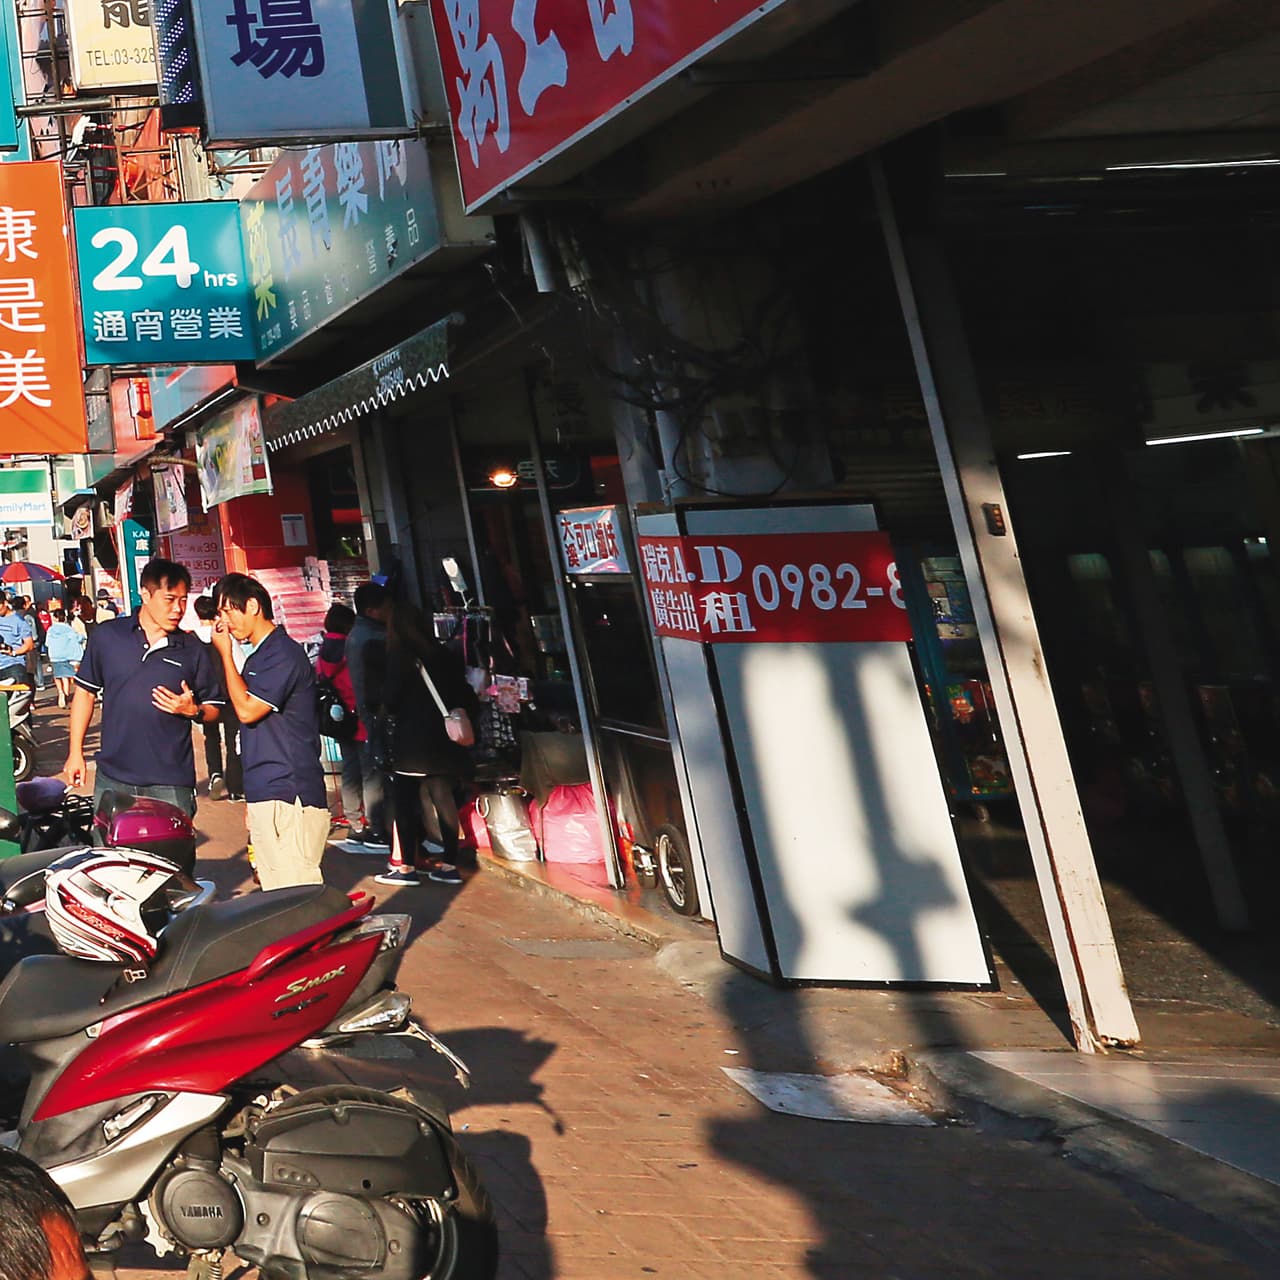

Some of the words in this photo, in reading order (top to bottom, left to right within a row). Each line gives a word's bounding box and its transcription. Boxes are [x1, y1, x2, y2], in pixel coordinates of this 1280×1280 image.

[92, 308, 244, 343] 通宵營業
[650, 587, 757, 634] 廣告出租
[180, 1204, 224, 1219] YAMAHA
